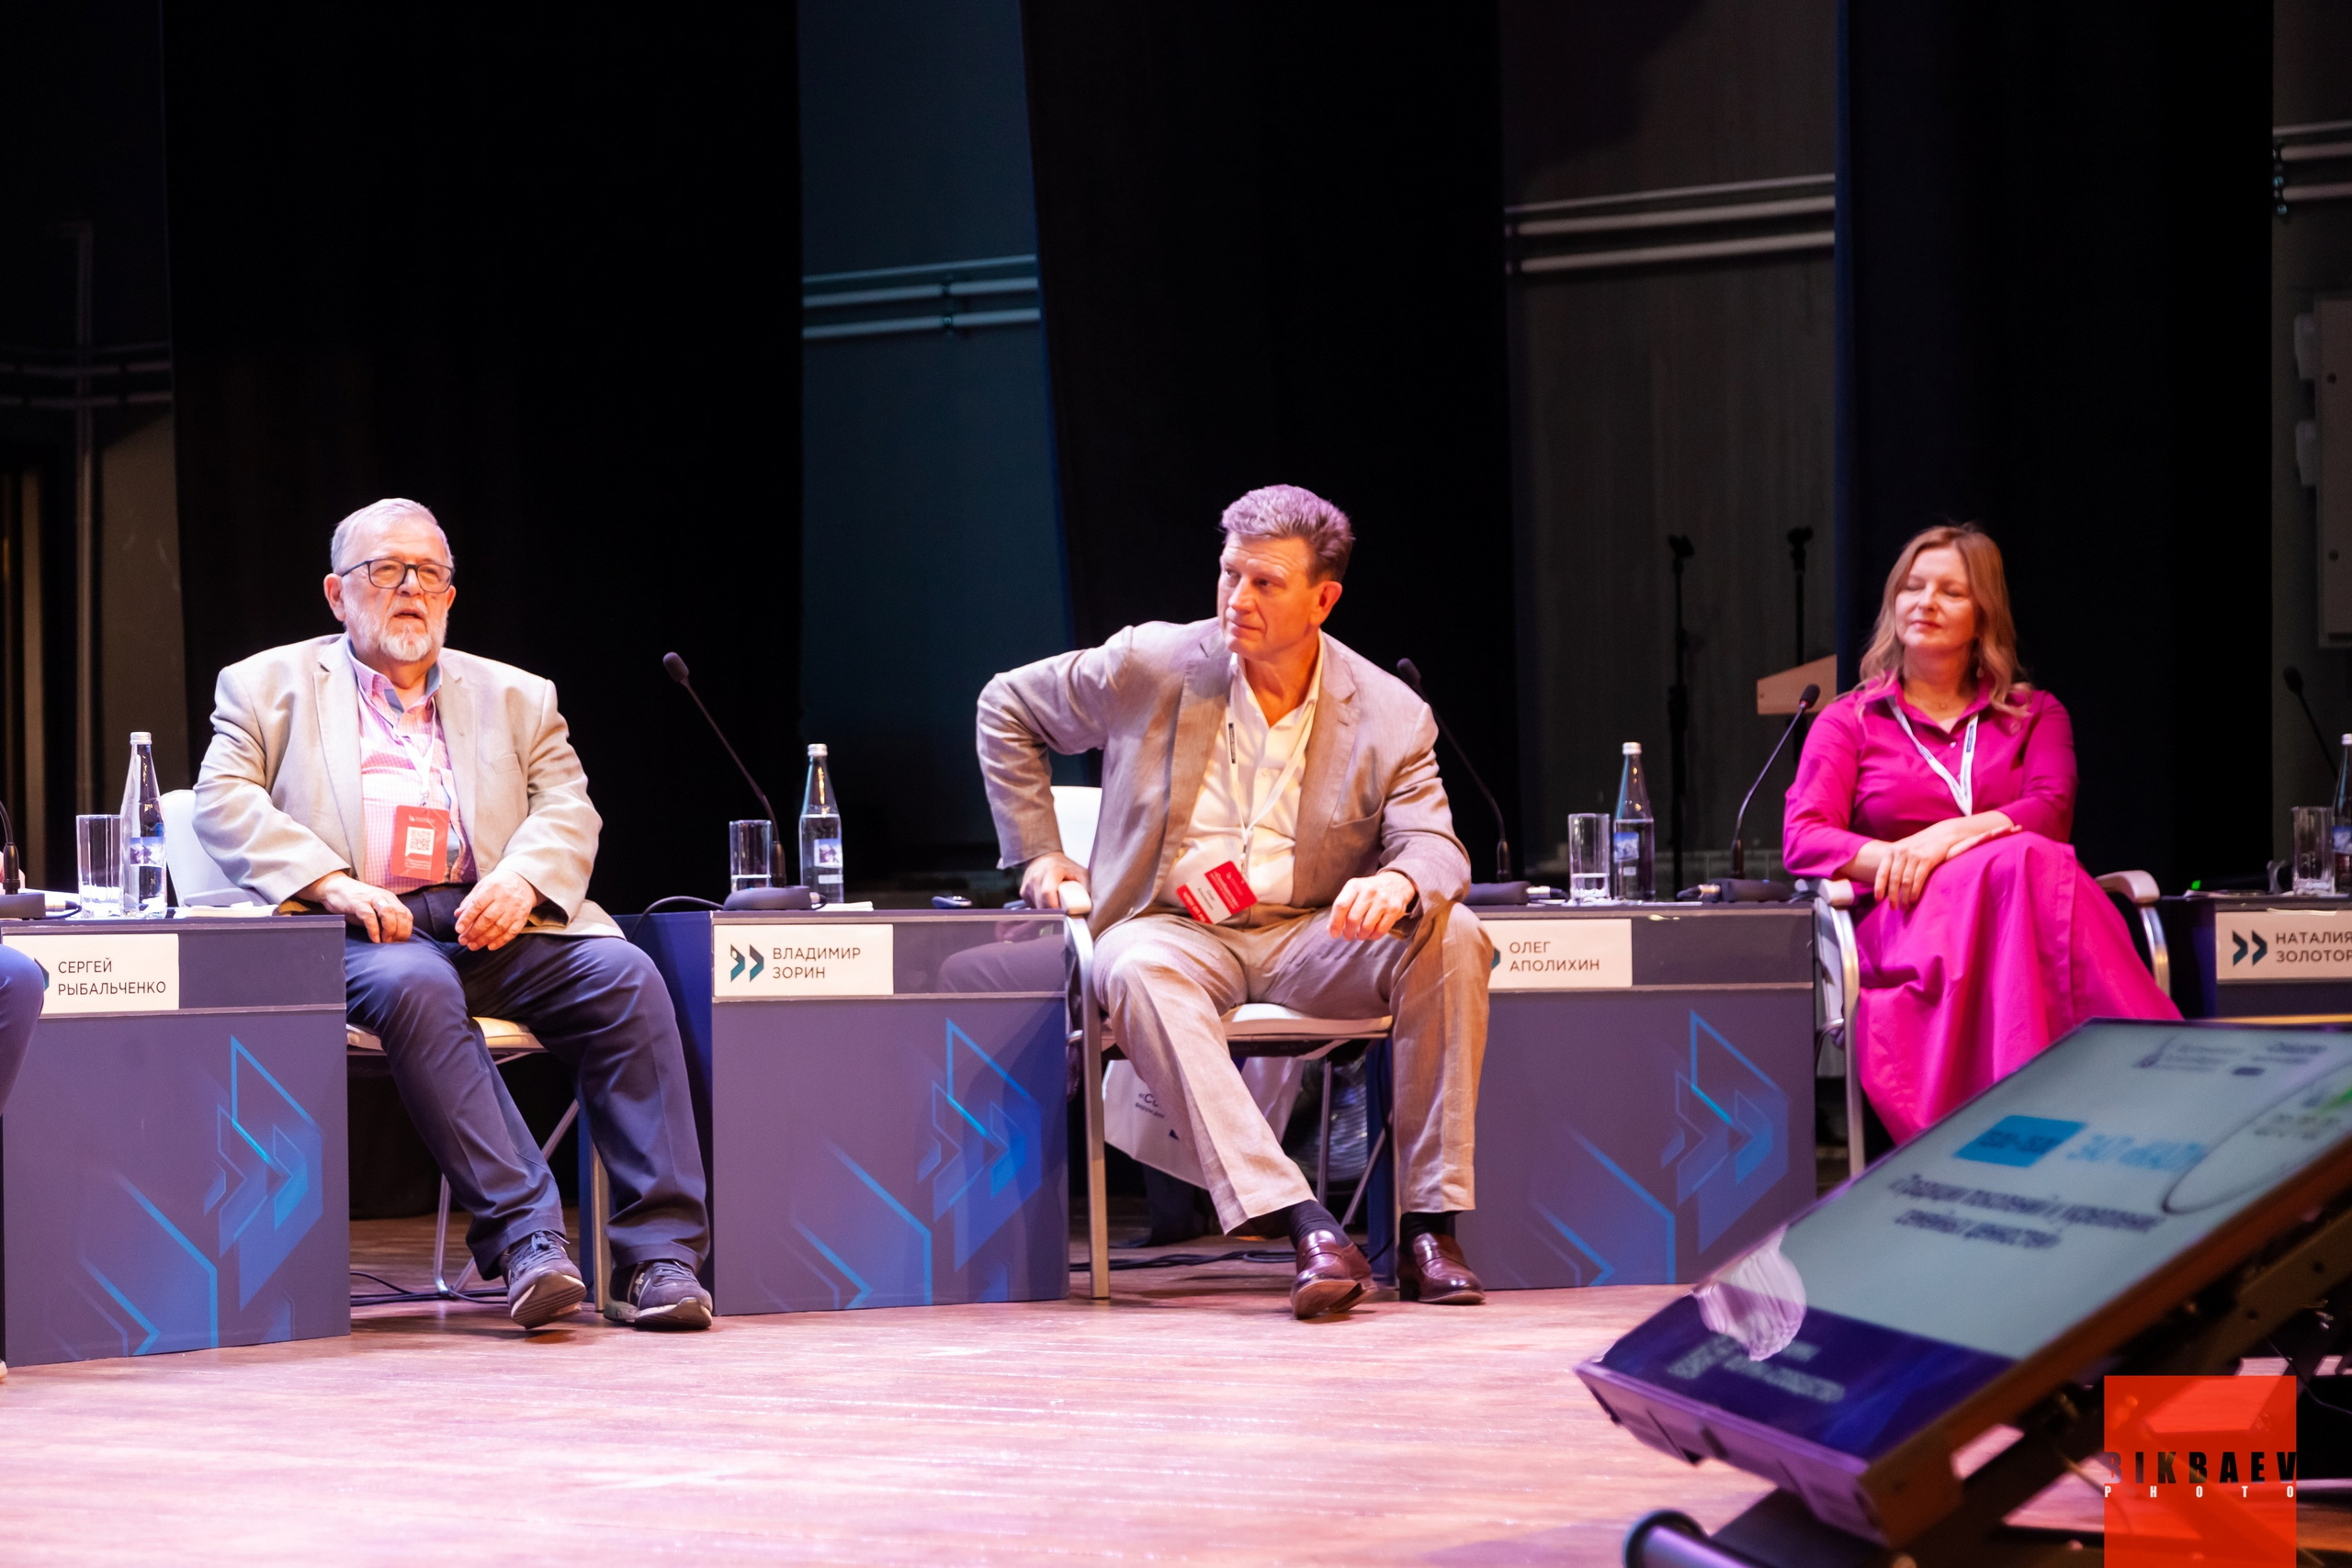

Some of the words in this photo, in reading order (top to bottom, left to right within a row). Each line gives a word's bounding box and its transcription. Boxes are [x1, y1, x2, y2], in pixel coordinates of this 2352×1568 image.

[2276, 931, 2352, 944] НАТАЛИЯ
[772, 947, 861, 962] ВЛАДИМИР
[1509, 941, 1551, 954] ОЛЕГ
[57, 957, 112, 974] СЕРГЕЙ
[1510, 958, 1600, 972] АПОЛИХИН
[772, 966, 825, 979] ЗОРИН
[57, 980, 166, 996] РЫБАЛЬЧЕНКО
